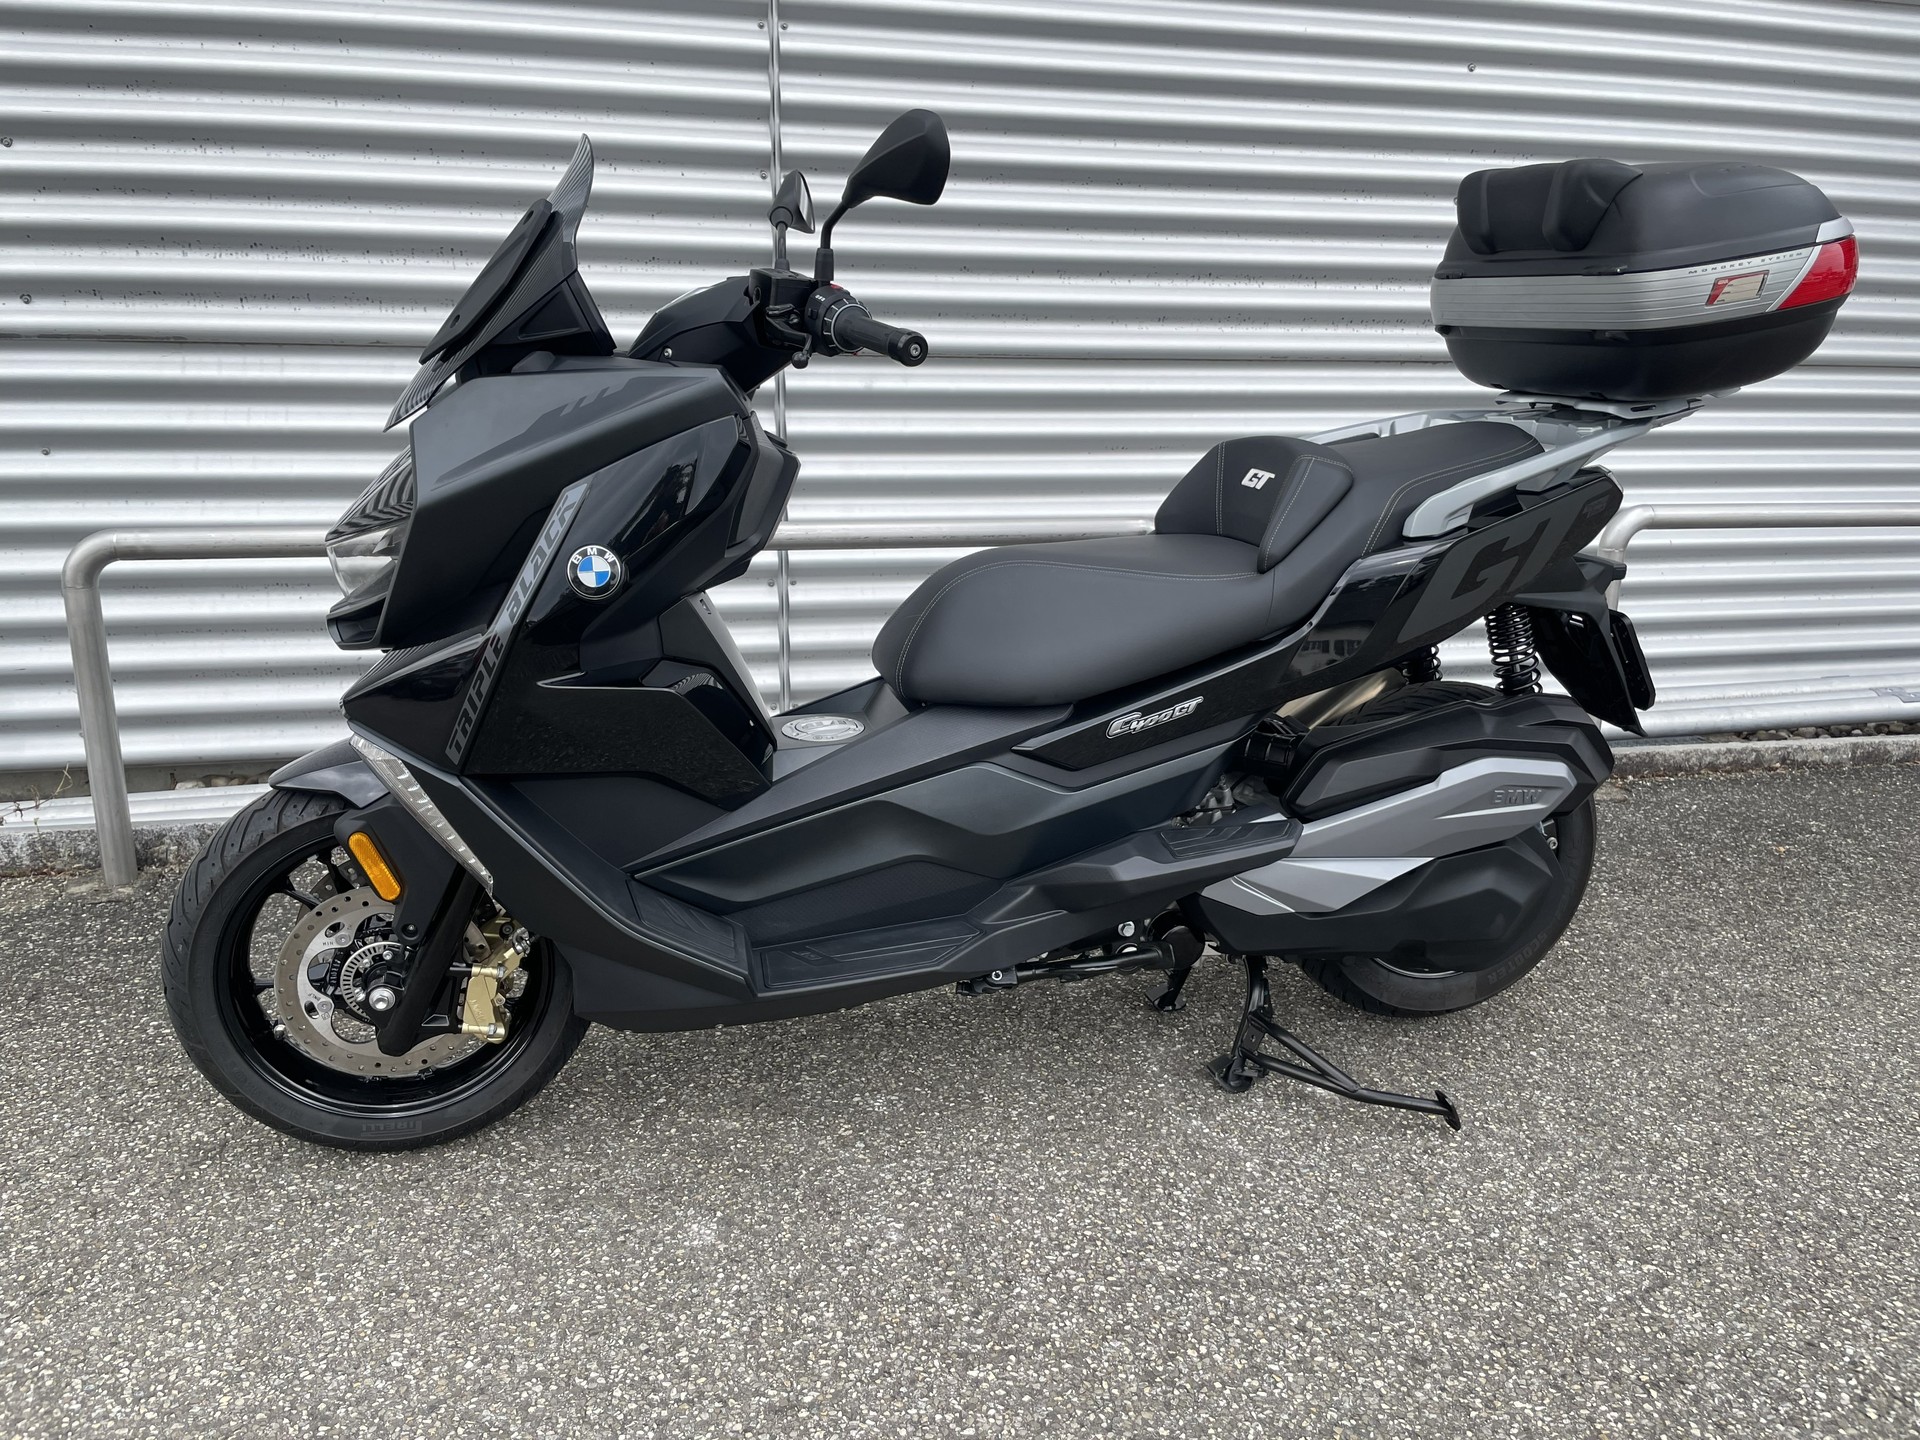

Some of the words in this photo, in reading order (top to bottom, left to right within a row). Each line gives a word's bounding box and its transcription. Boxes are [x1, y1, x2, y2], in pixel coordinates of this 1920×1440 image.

[1688, 261, 1753, 275] MONOKEY
[1760, 252, 1803, 263] SYSTEM
[1241, 468, 1276, 490] GT
[571, 547, 615, 565] BMW
[449, 631, 504, 761] TRIPLE
[506, 494, 576, 624] BLACK
[1493, 789, 1543, 804] BMW
[1487, 932, 1548, 985] SCOOTER
[361, 1119, 424, 1137] PIRELLI
